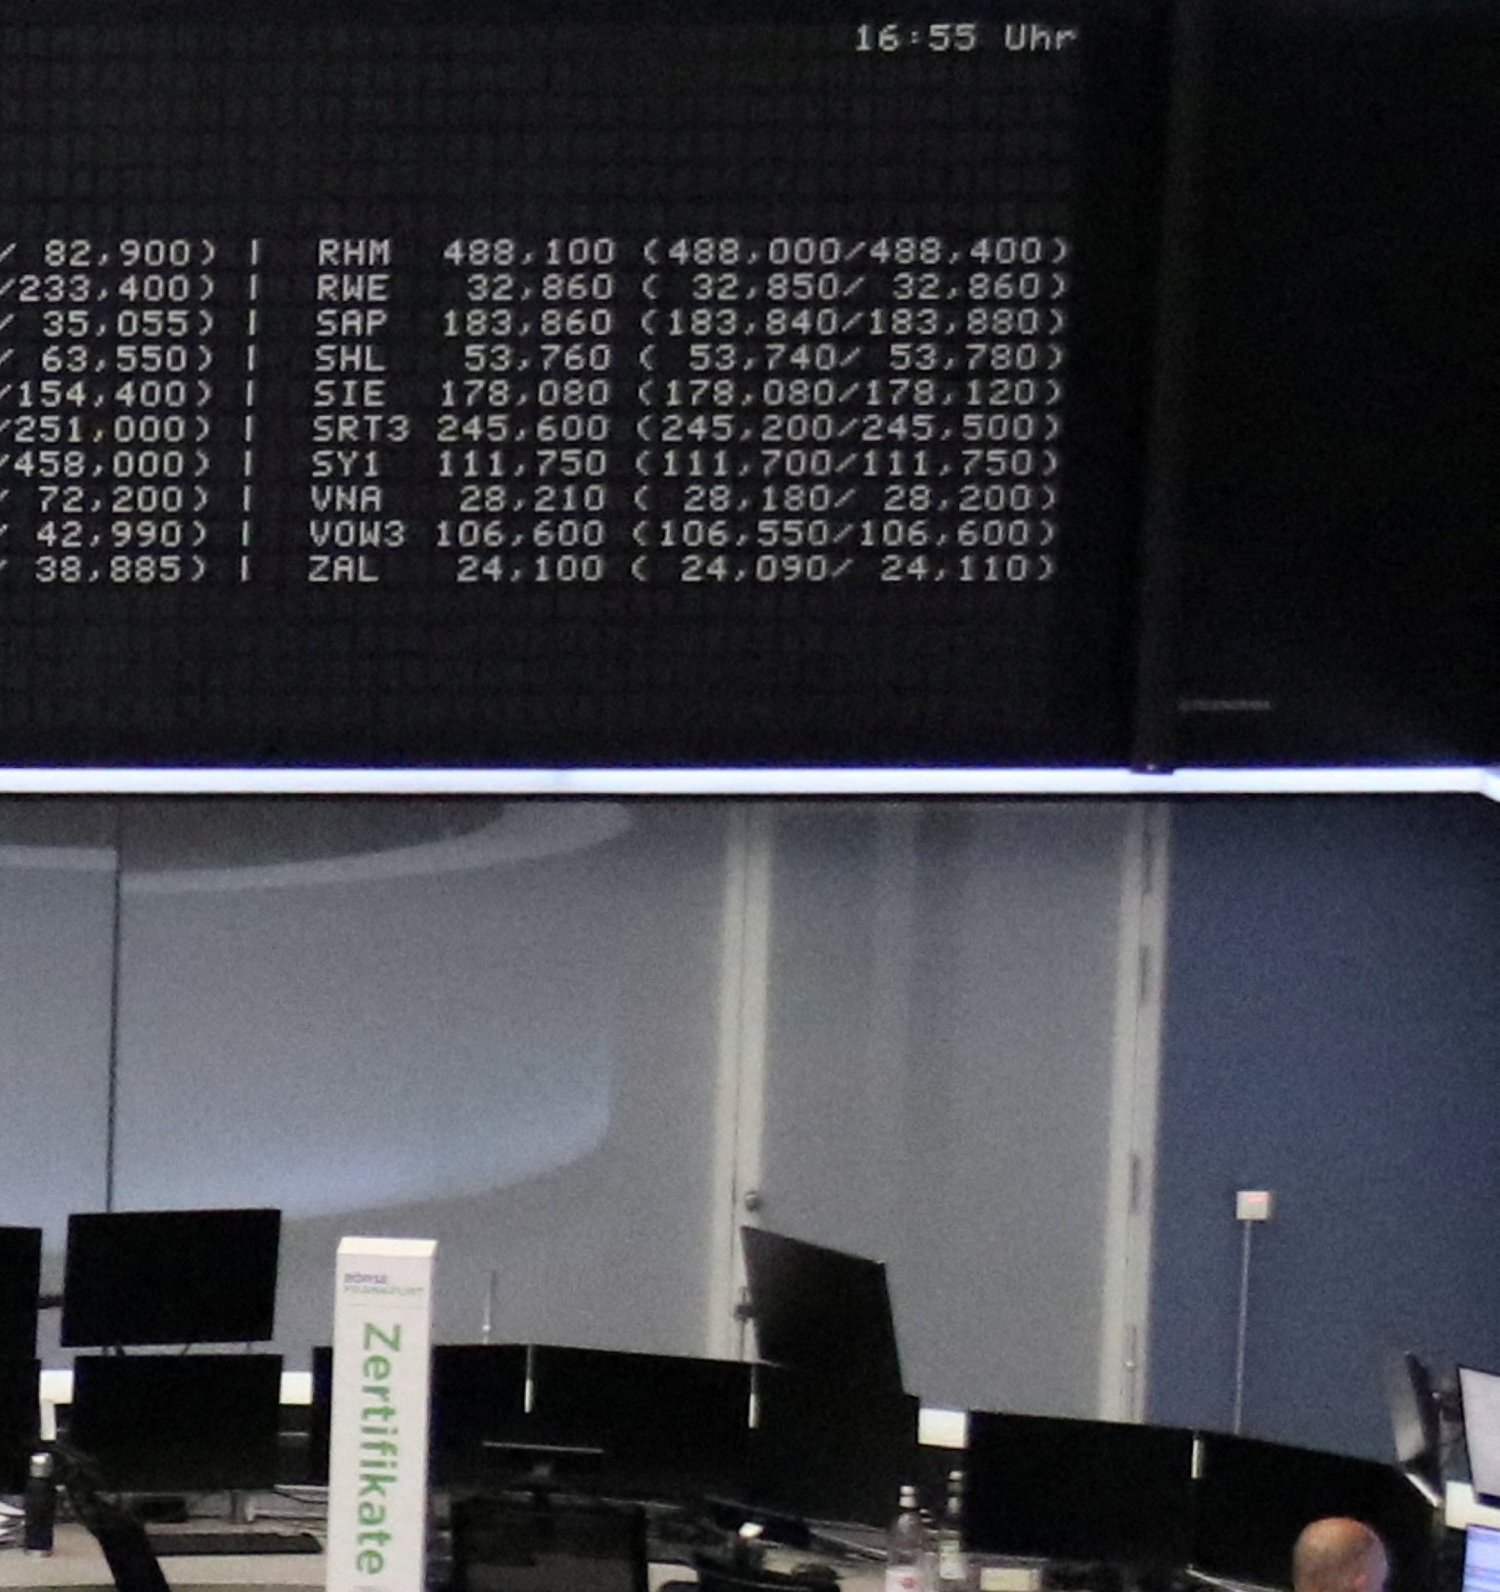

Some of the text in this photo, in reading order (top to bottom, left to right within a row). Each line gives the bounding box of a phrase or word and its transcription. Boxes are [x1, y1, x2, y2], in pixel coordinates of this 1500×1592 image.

[856, 22, 1077, 53] 16:55 Uhr
[317, 237, 391, 267] RHM
[442, 236, 616, 267] 488,100
[316, 272, 390, 303] RWE
[467, 272, 614, 302] 32,860
[315, 307, 389, 338] SAP
[444, 307, 613, 338] 183,860
[314, 343, 386, 373] SHL
[464, 342, 612, 373] 53,760
[313, 378, 386, 408] SIE
[441, 378, 611, 408] 178,080
[312, 413, 410, 443] SRT3
[436, 413, 609, 443] 245,600
[311, 448, 379, 479] SY1
[438, 447, 608, 478] 111,750
[310, 484, 383, 513] VNA
[458, 483, 606, 513] 28,210
[308, 518, 406, 548] VOW3
[436, 518, 605, 548] 106,600
[307, 554, 380, 583] ZAL
[456, 553, 604, 583] 24,100
[355, 1321, 402, 1576] Zertifikate
